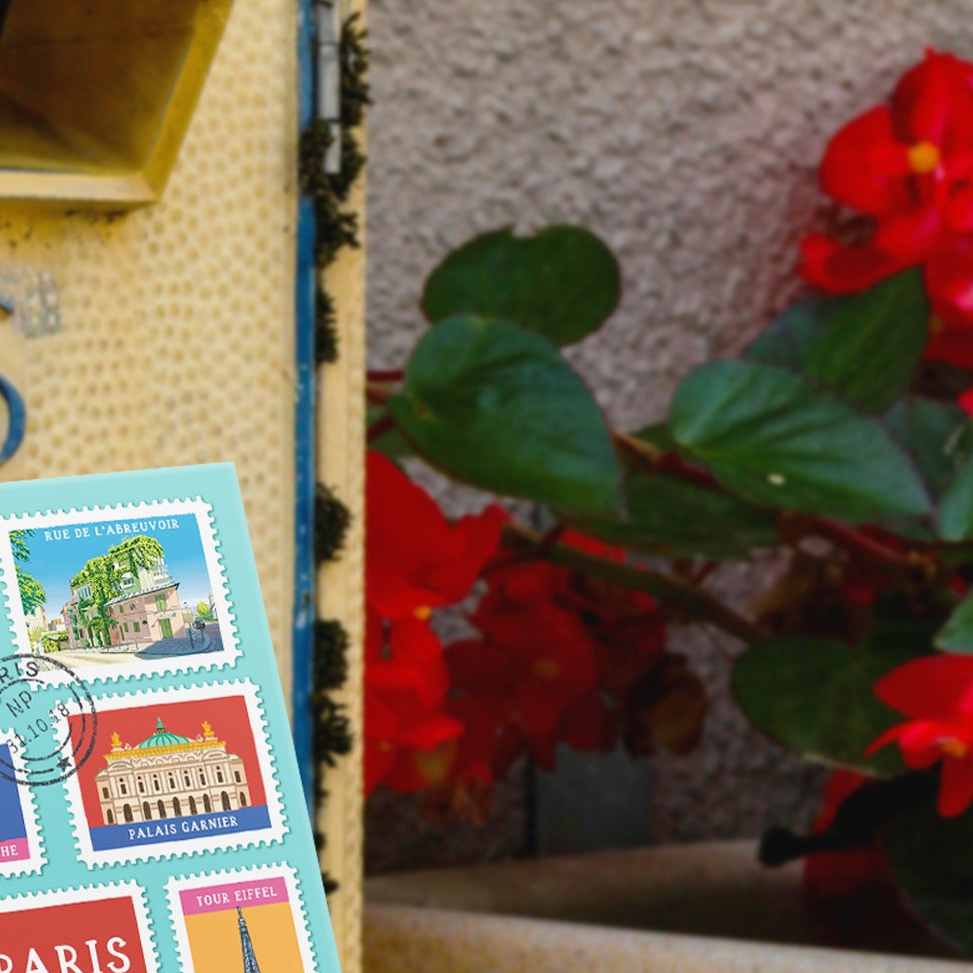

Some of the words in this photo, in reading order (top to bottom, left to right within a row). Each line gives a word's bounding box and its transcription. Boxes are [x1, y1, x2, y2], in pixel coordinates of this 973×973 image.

[43, 529, 70, 541] RUE
[75, 527, 90, 539] DE
[94, 519, 180, 537] L'ABREUVOIR
[5, 690, 33, 717] NP
[128, 824, 177, 840] PALAIS
[181, 816, 239, 833] GARNIER
[196, 892, 230, 907] TOUR
[234, 886, 277, 902] EIFFEL
